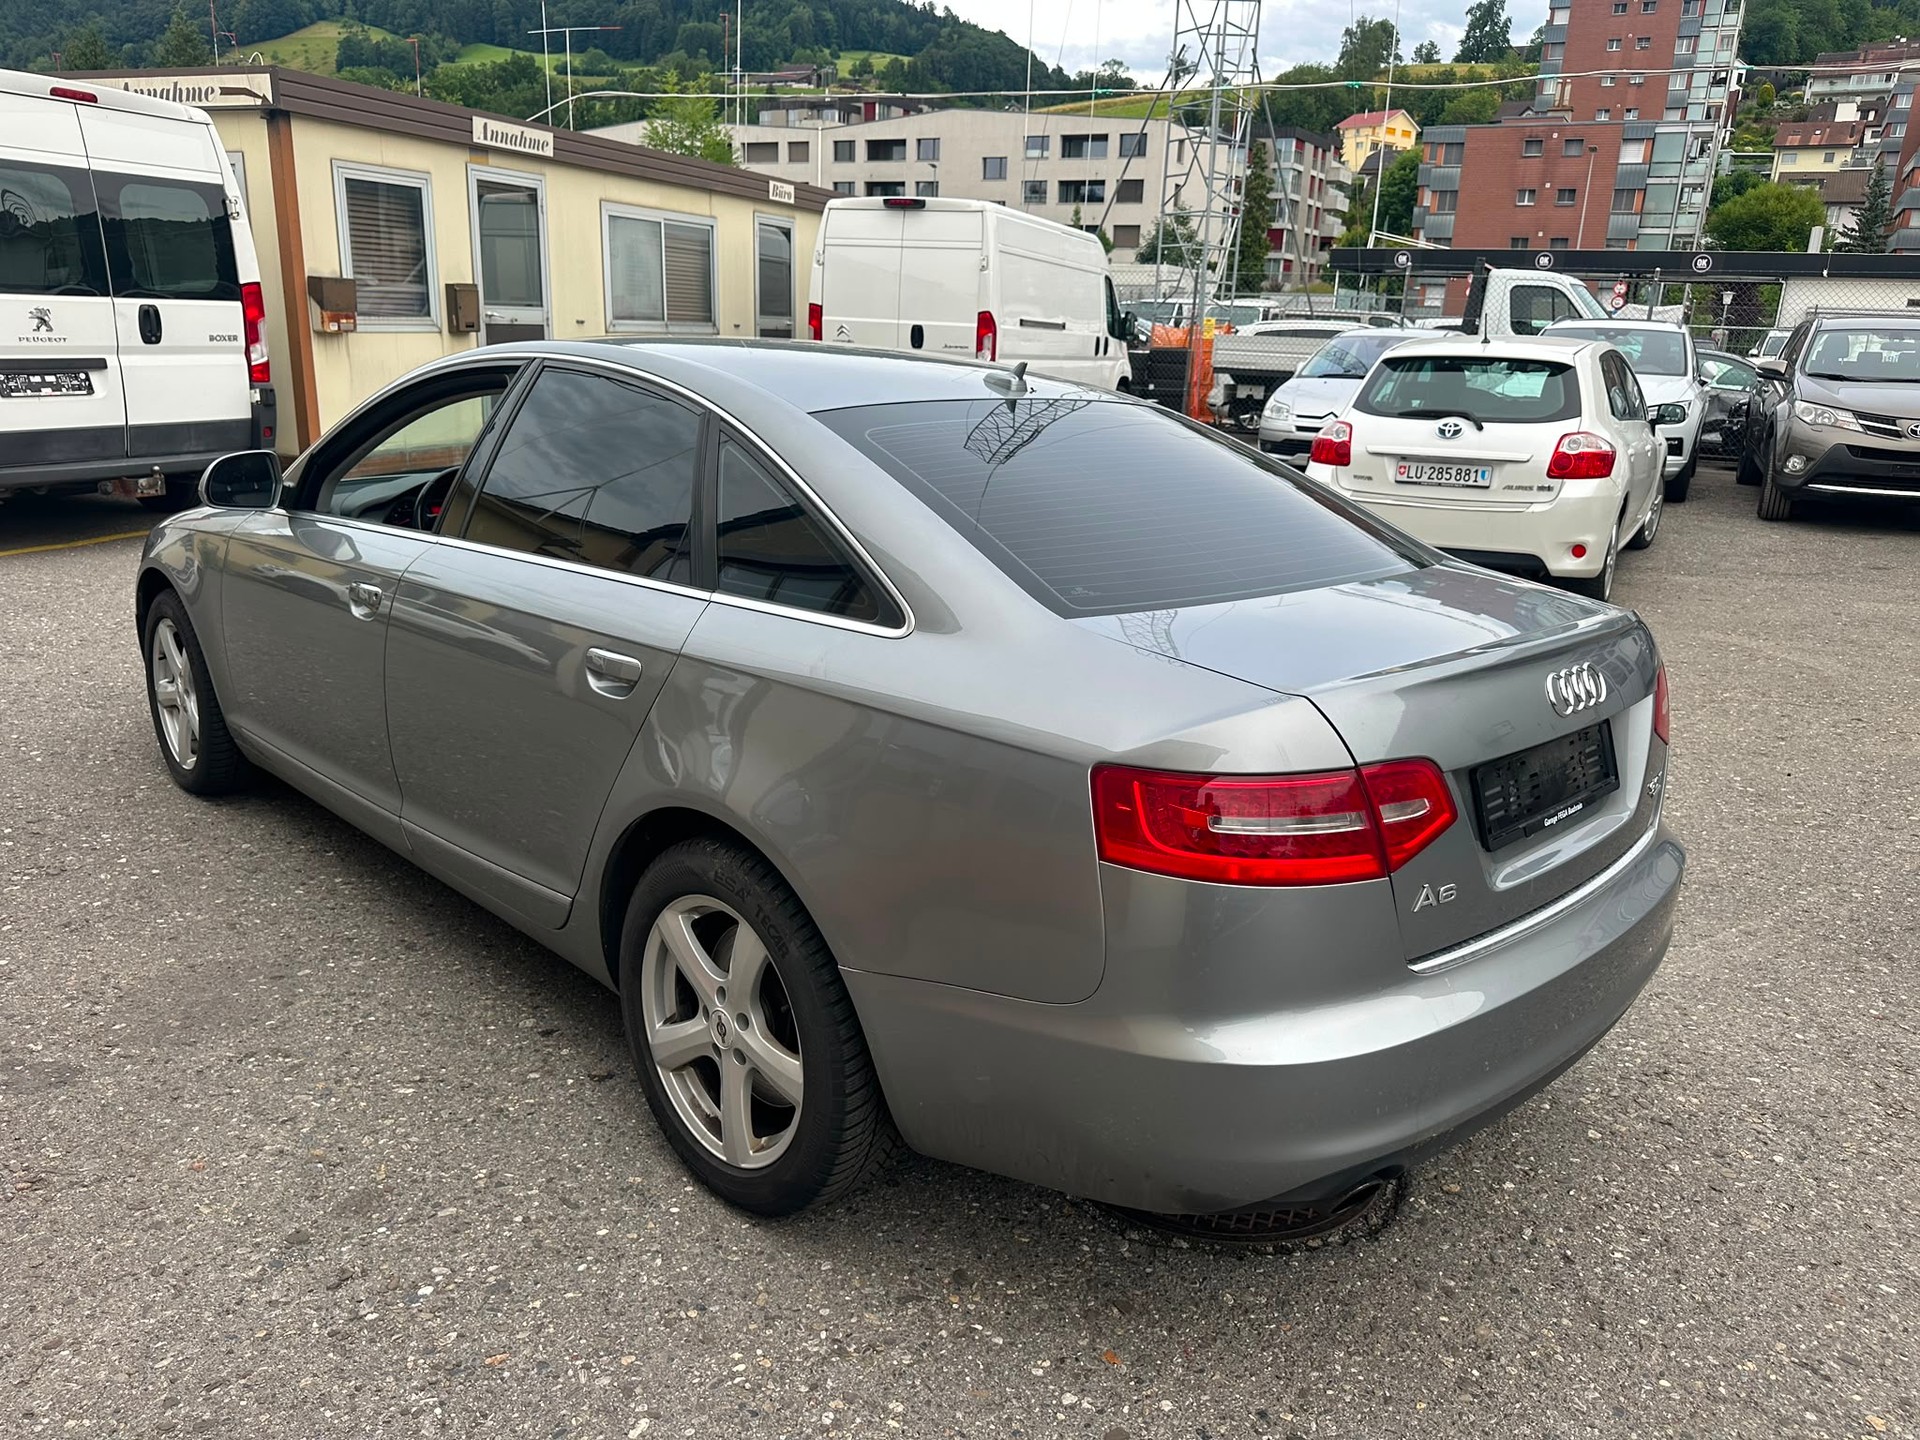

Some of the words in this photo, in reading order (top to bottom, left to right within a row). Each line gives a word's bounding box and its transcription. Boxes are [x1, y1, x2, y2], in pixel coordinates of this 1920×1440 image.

[123, 82, 215, 103] ahme
[478, 122, 549, 153] Annahme
[772, 183, 793, 201] Büro
[209, 334, 239, 342] BOXER
[1411, 883, 1457, 913] A6
